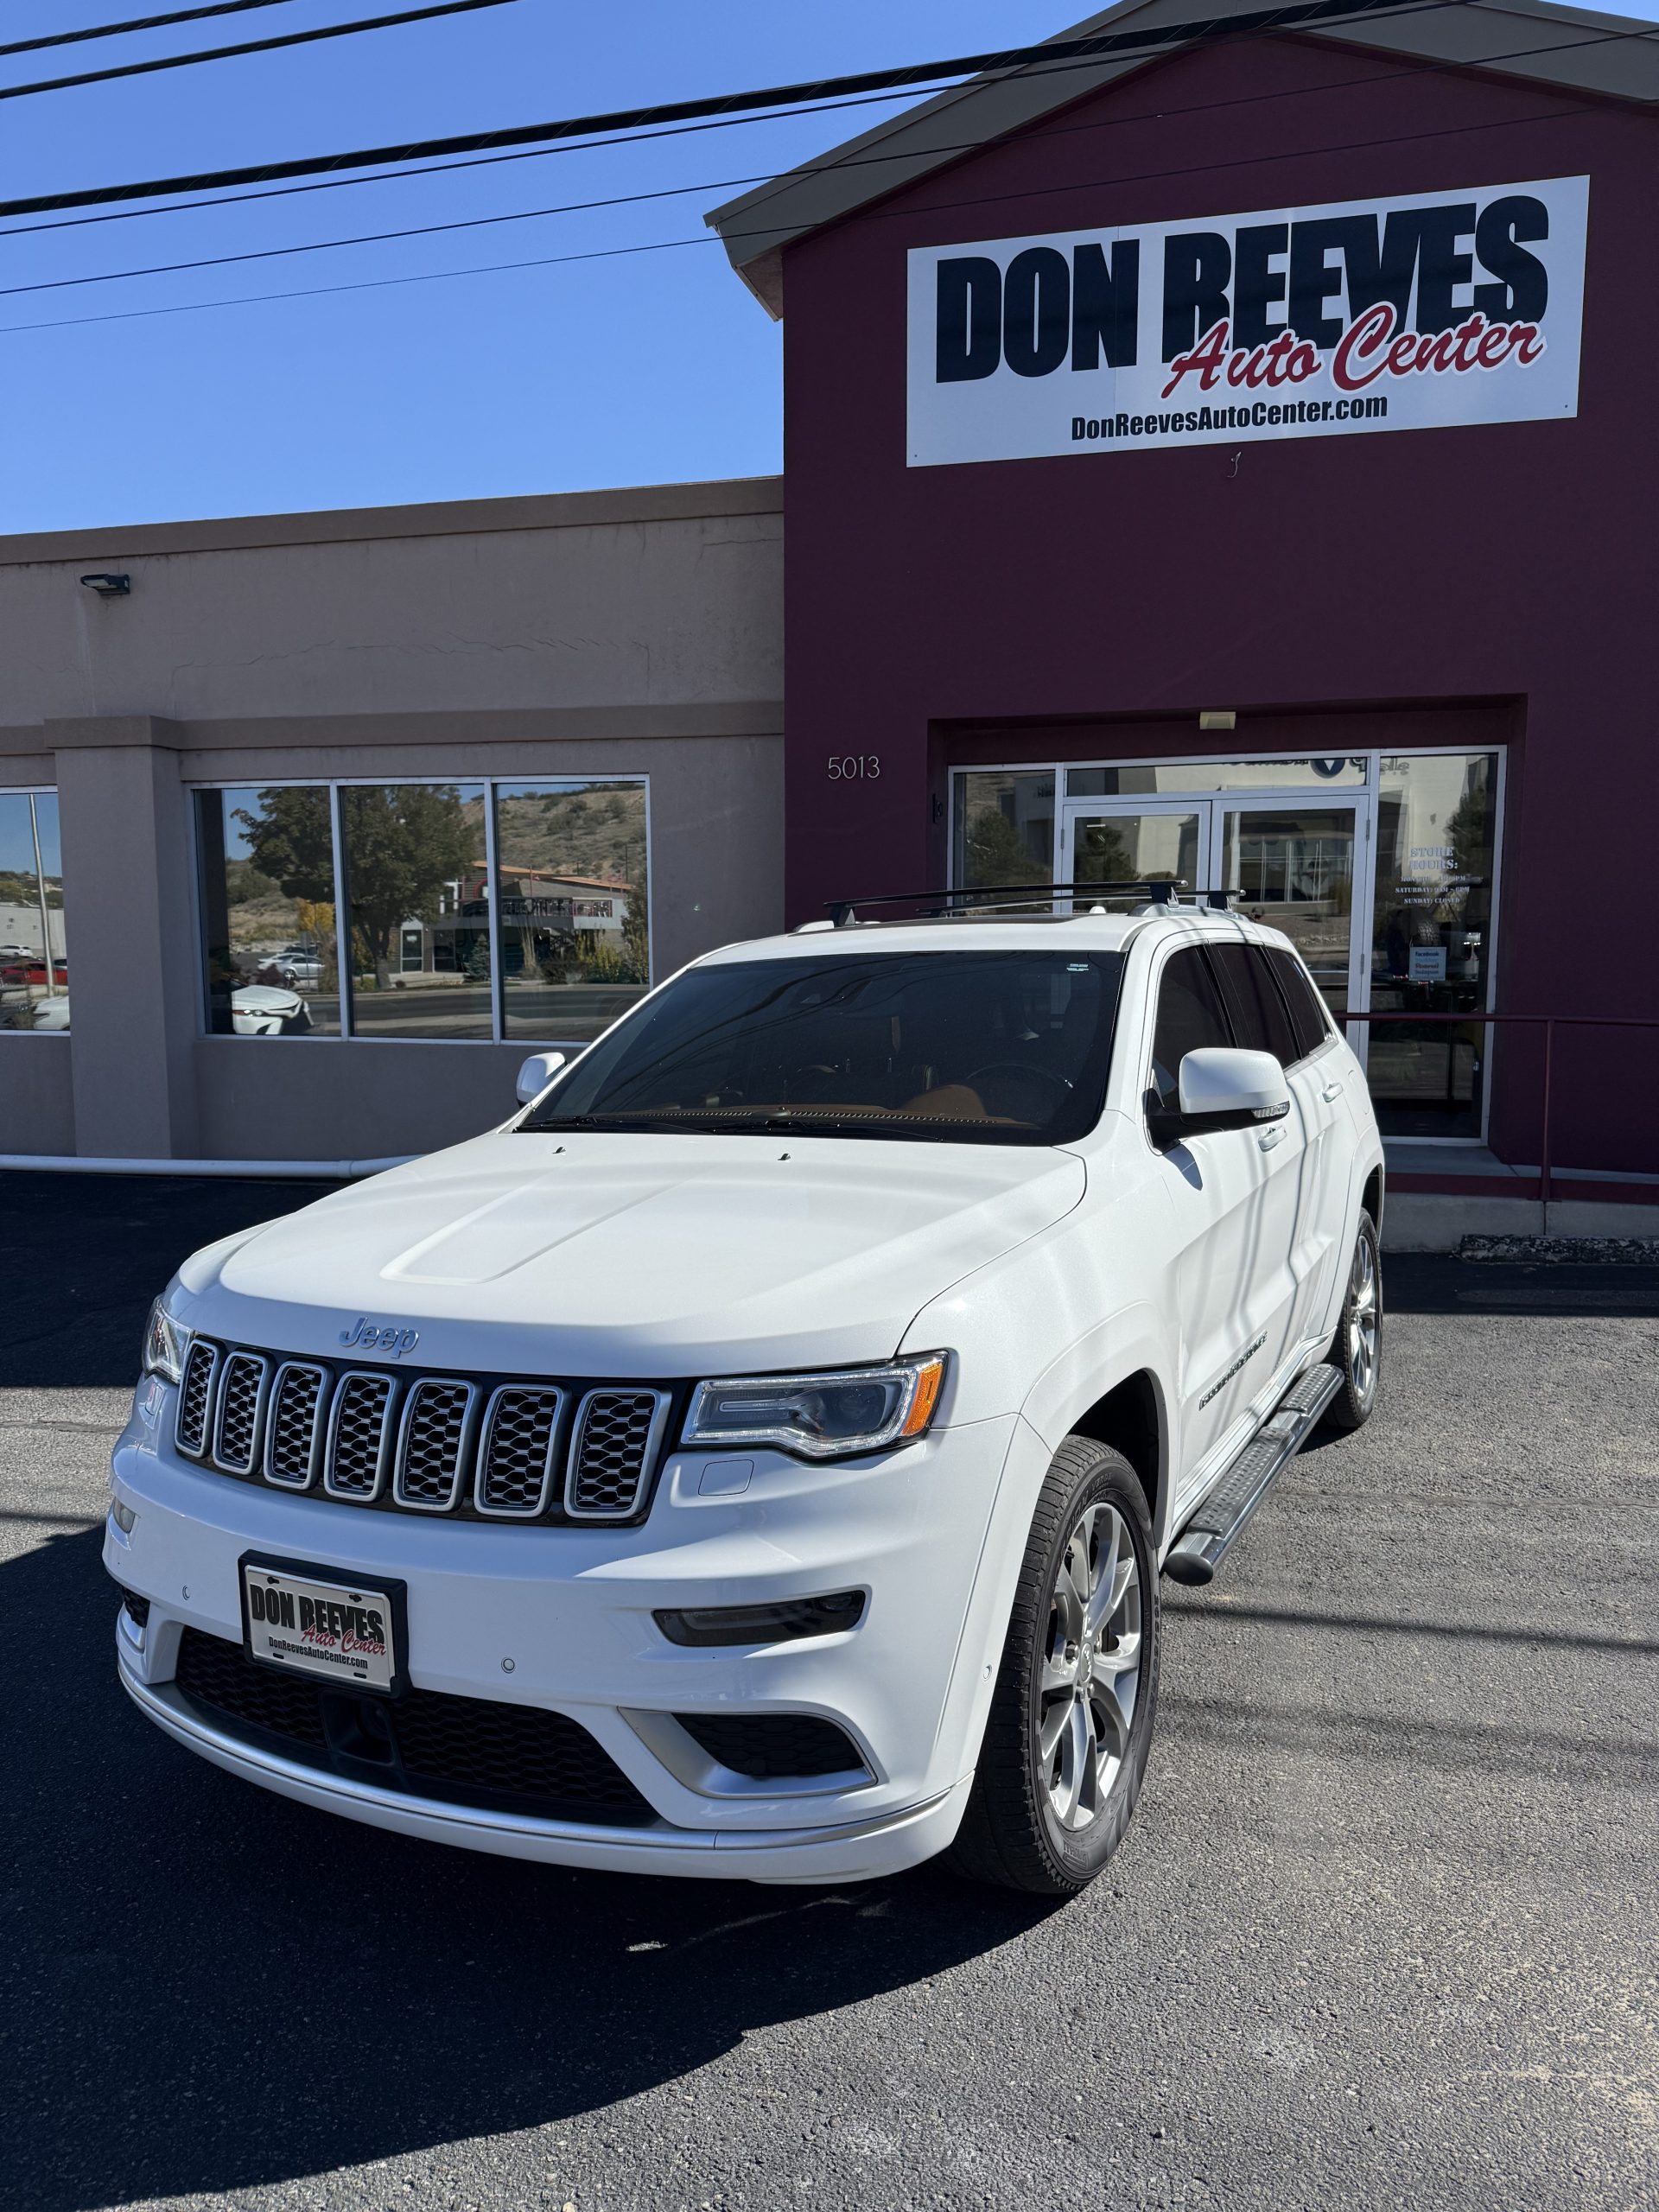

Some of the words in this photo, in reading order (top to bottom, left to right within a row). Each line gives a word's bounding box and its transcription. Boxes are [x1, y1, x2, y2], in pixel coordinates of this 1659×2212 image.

[936, 238, 1140, 384] DON
[1162, 195, 1549, 364] REEVES
[1160, 316, 1323, 400] Auto
[1330, 301, 1545, 393] Center
[1071, 395, 1388, 441] DonReevesAutoCenter.com
[828, 755, 880, 779] 5013
[1409, 859, 1458, 869] HOURS:
[1410, 846, 1453, 857] STORE
[339, 1317, 419, 1359] Jeep
[251, 1583, 296, 1630] DON
[298, 1595, 385, 1644] REEVES
[269, 1636, 368, 1669] DonReevesAutoCenter.com
[302, 1623, 336, 1647] Auto
[340, 1629, 387, 1656] Center
